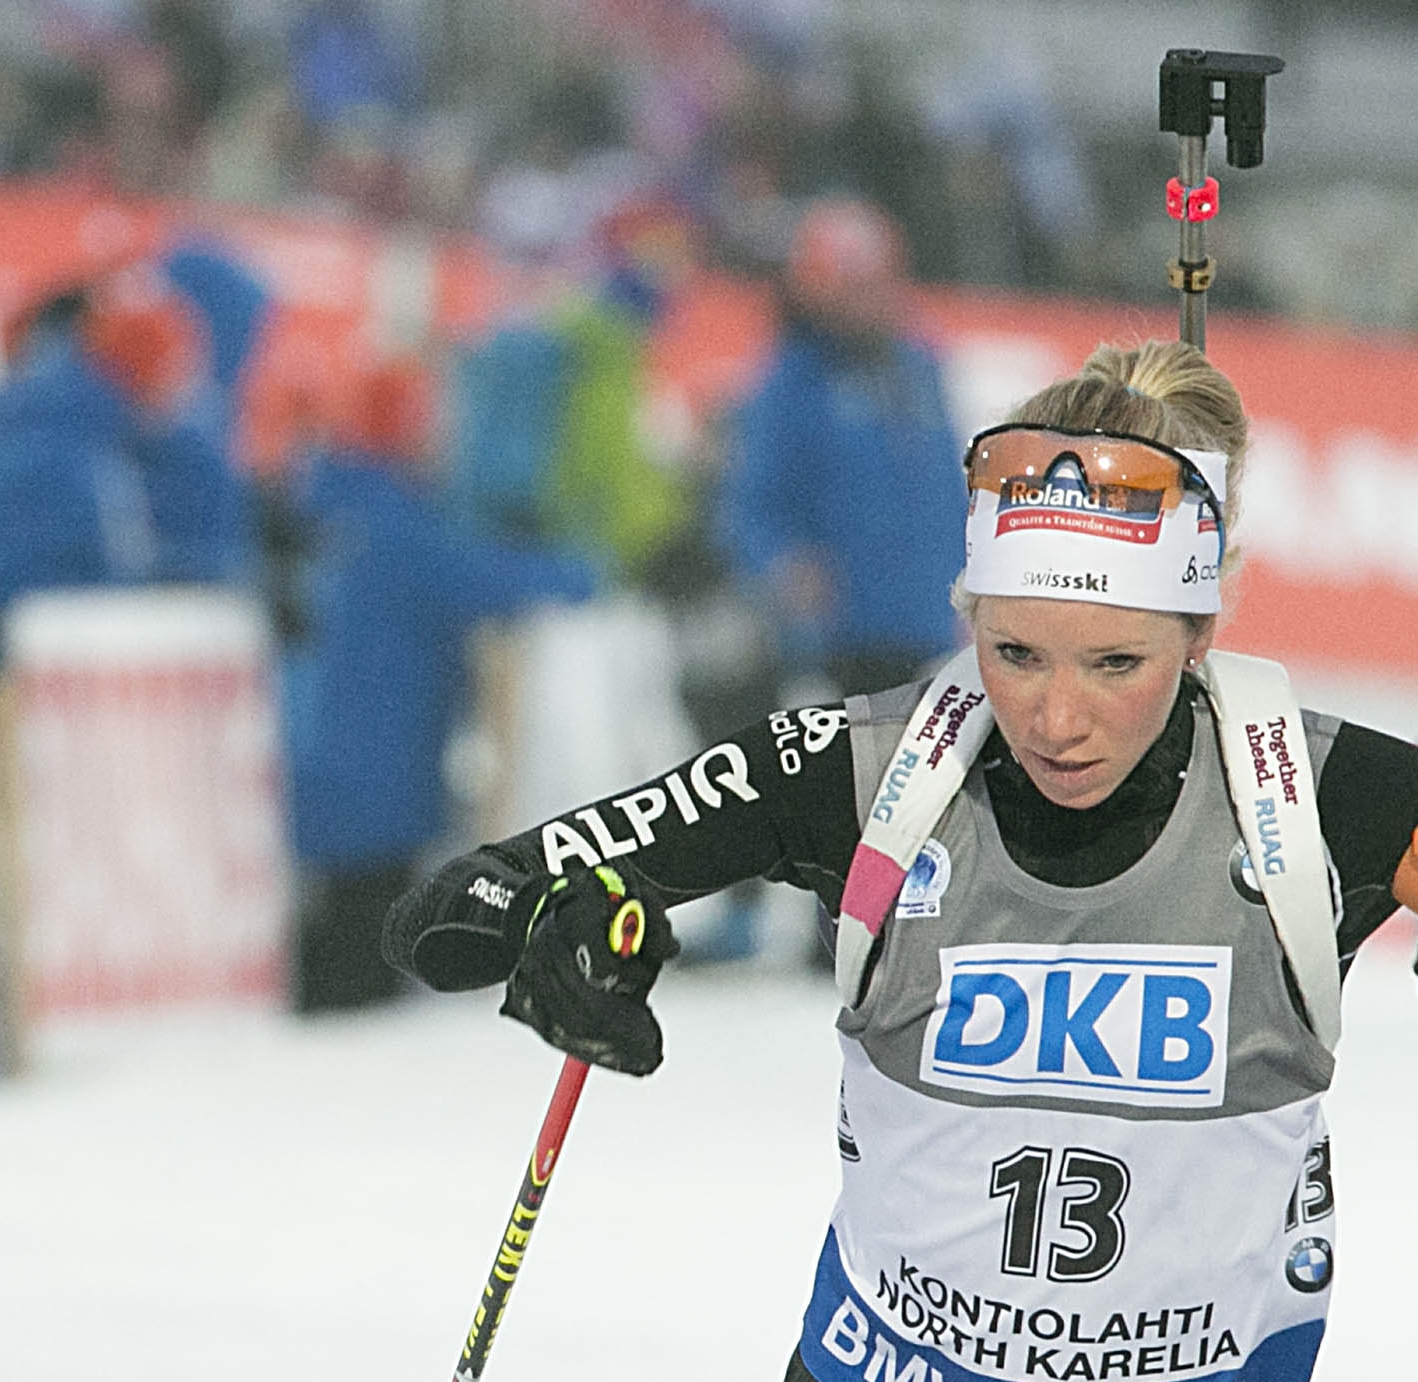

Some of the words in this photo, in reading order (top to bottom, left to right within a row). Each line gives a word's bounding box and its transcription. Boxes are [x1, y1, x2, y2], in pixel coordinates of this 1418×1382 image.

[1010, 481, 1100, 508] Roland
[1021, 568, 1109, 593] swissski
[926, 690, 985, 770] Together
[1245, 723, 1275, 788] ahead.
[1267, 716, 1298, 805] Together
[541, 743, 760, 876] ALPIQ
[873, 748, 920, 825] RUAG
[1254, 797, 1286, 876] RUAG
[934, 971, 1214, 1081] DKB
[493, 1202, 540, 1283] LEKI
[990, 1144, 1131, 1283] 13
[876, 1268, 1007, 1371] NORTH
[1025, 1330, 1241, 1382] KARELIA
[900, 1256, 1215, 1344] KONTIOLAHTI
